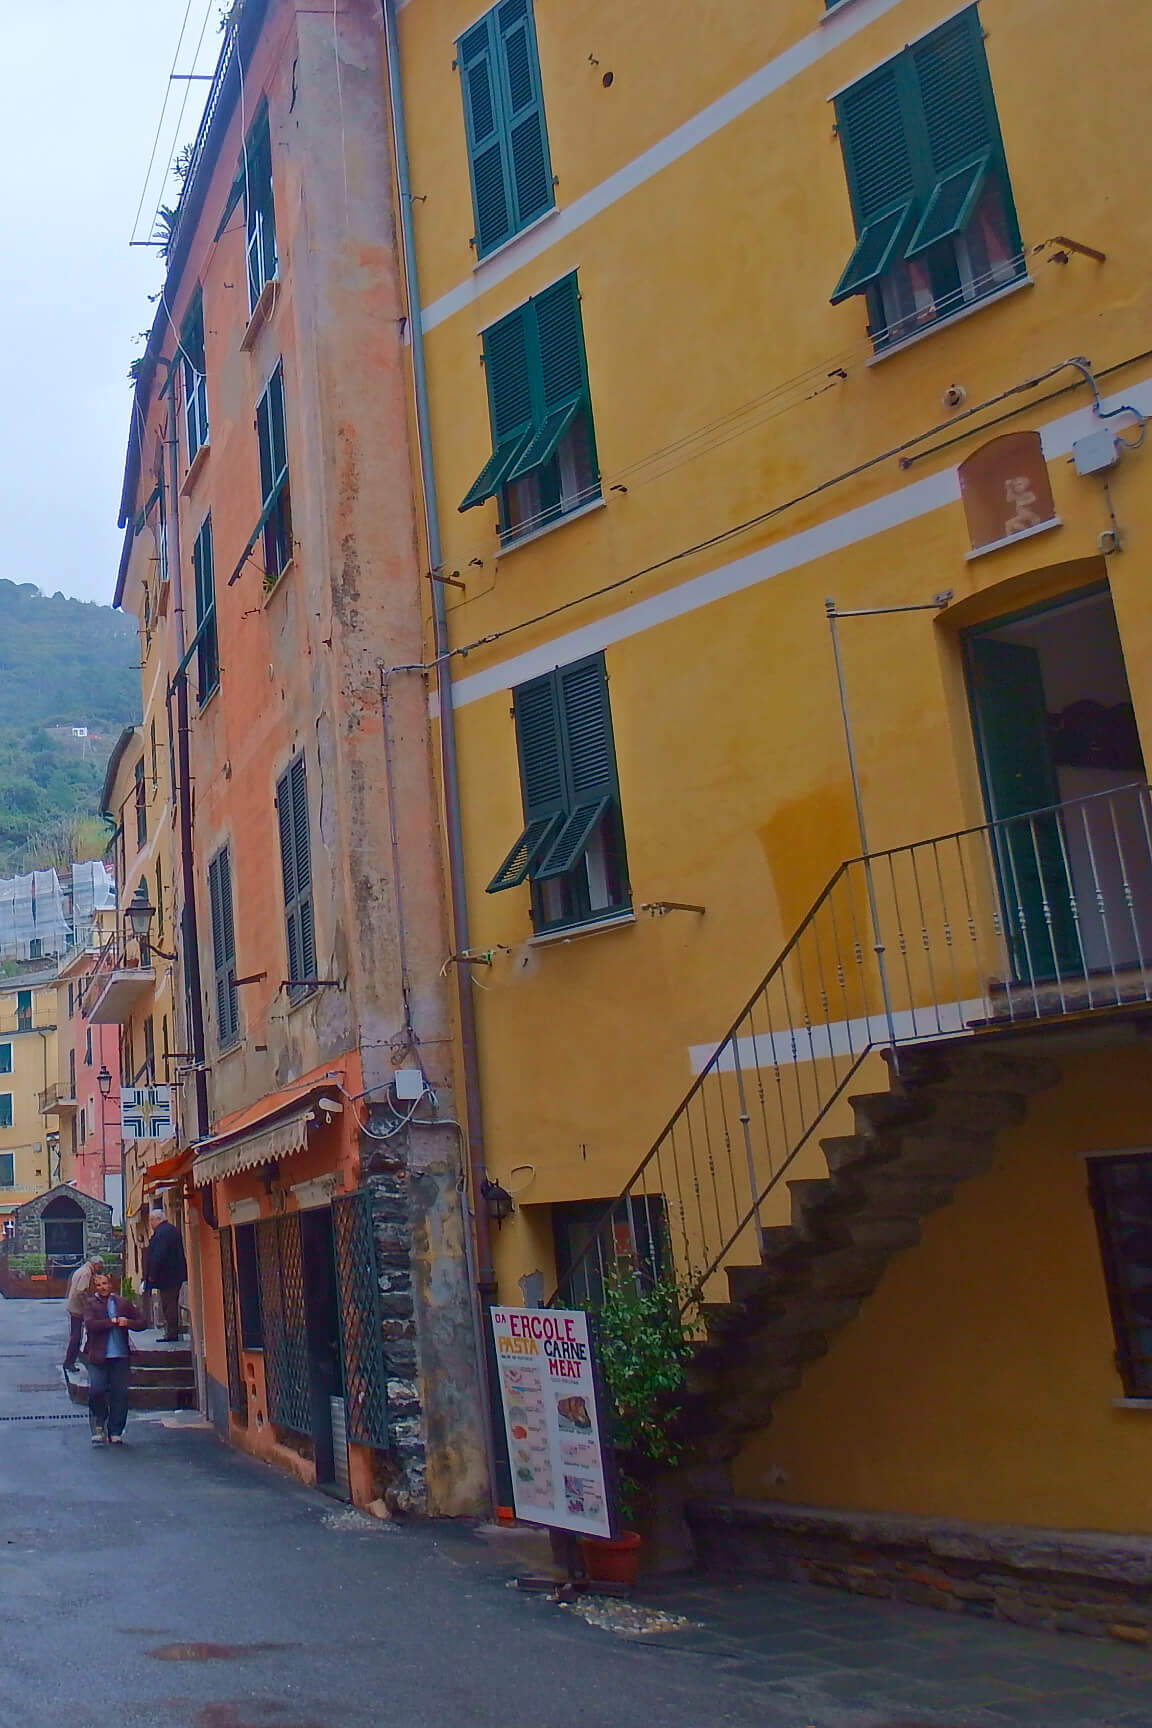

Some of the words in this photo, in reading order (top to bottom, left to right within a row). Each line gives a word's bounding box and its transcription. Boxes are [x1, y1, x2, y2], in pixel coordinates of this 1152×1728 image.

[509, 1314, 576, 1342] ERCOLE
[497, 1336, 539, 1355] PASTA
[544, 1340, 588, 1361] CARNE
[548, 1358, 582, 1378] MEAT
